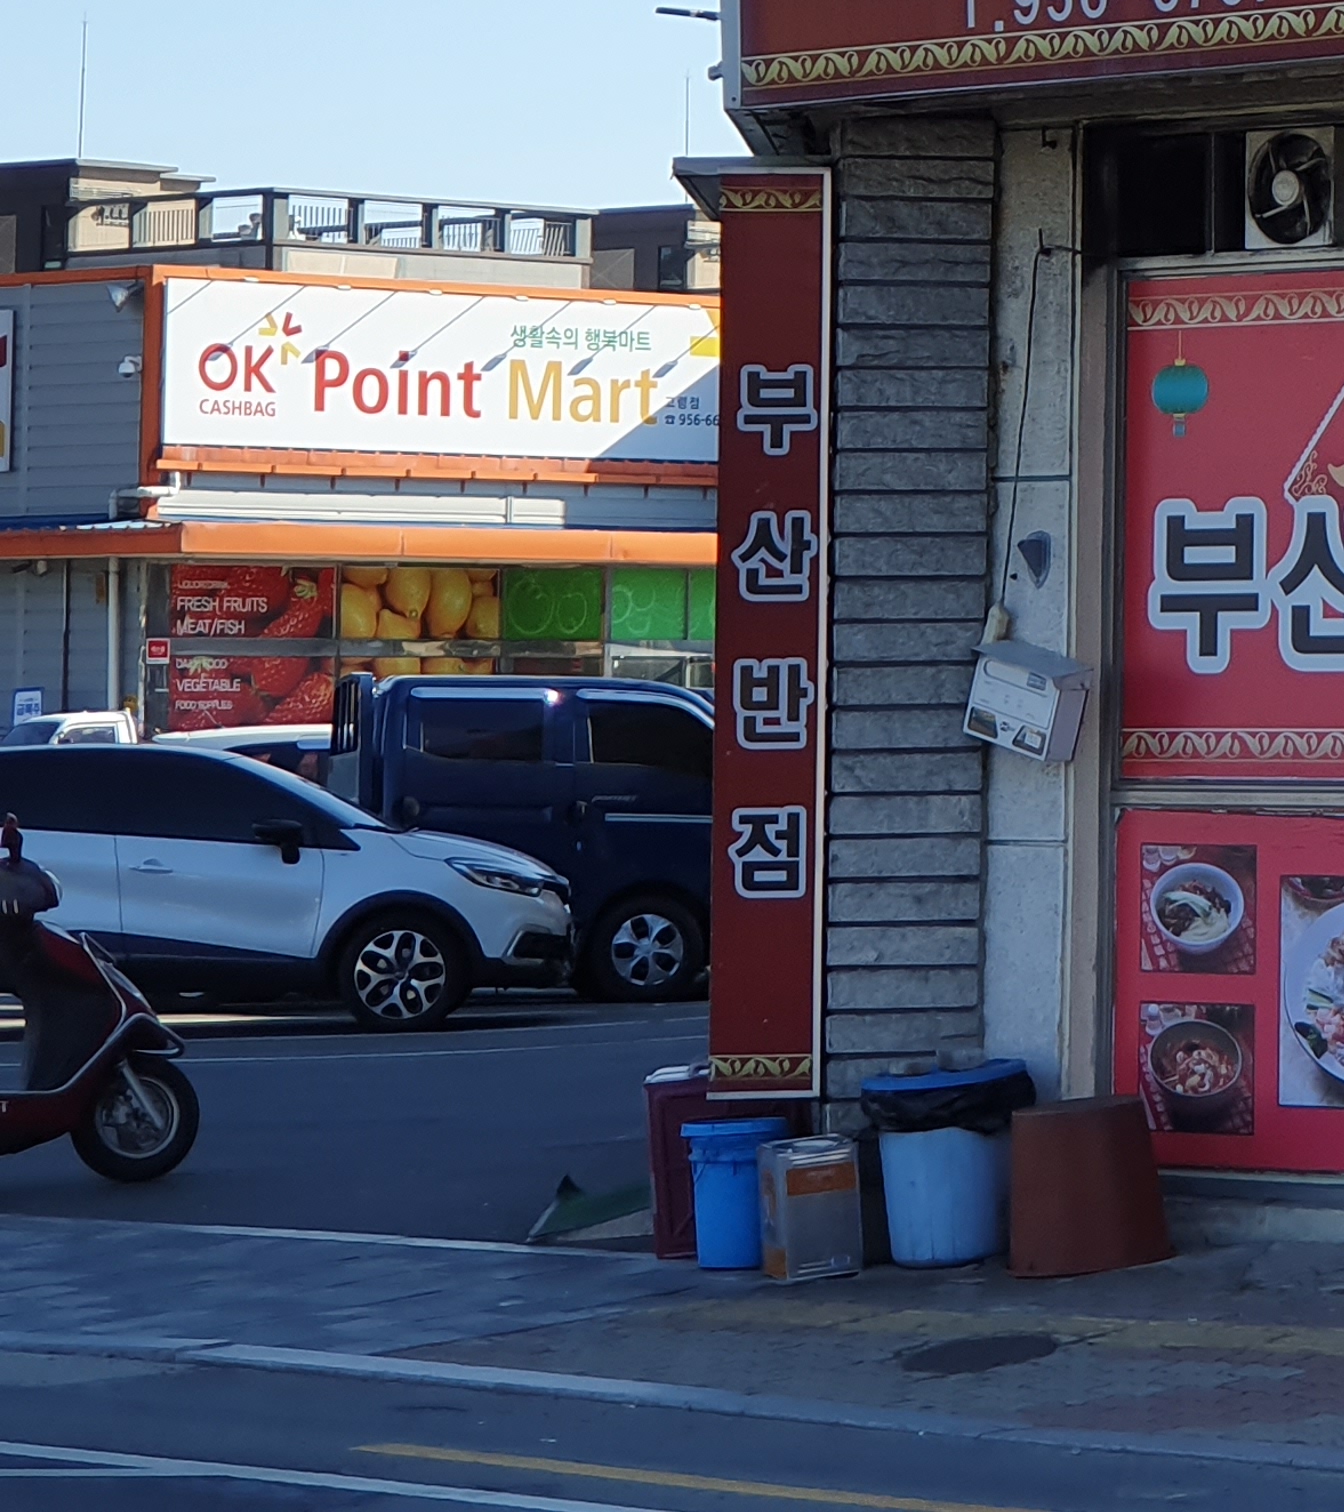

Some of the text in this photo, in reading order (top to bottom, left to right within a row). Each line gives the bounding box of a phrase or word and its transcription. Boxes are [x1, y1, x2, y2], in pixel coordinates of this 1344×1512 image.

[585, 328, 652, 353] 행복마트
[198, 343, 658, 426] OK Point Mart
[199, 399, 276, 417] CASHBAG
[176, 596, 268, 613] FRESH FRUITS
[728, 364, 817, 899] 부산반점
[176, 678, 241, 692] VEGETABLE
